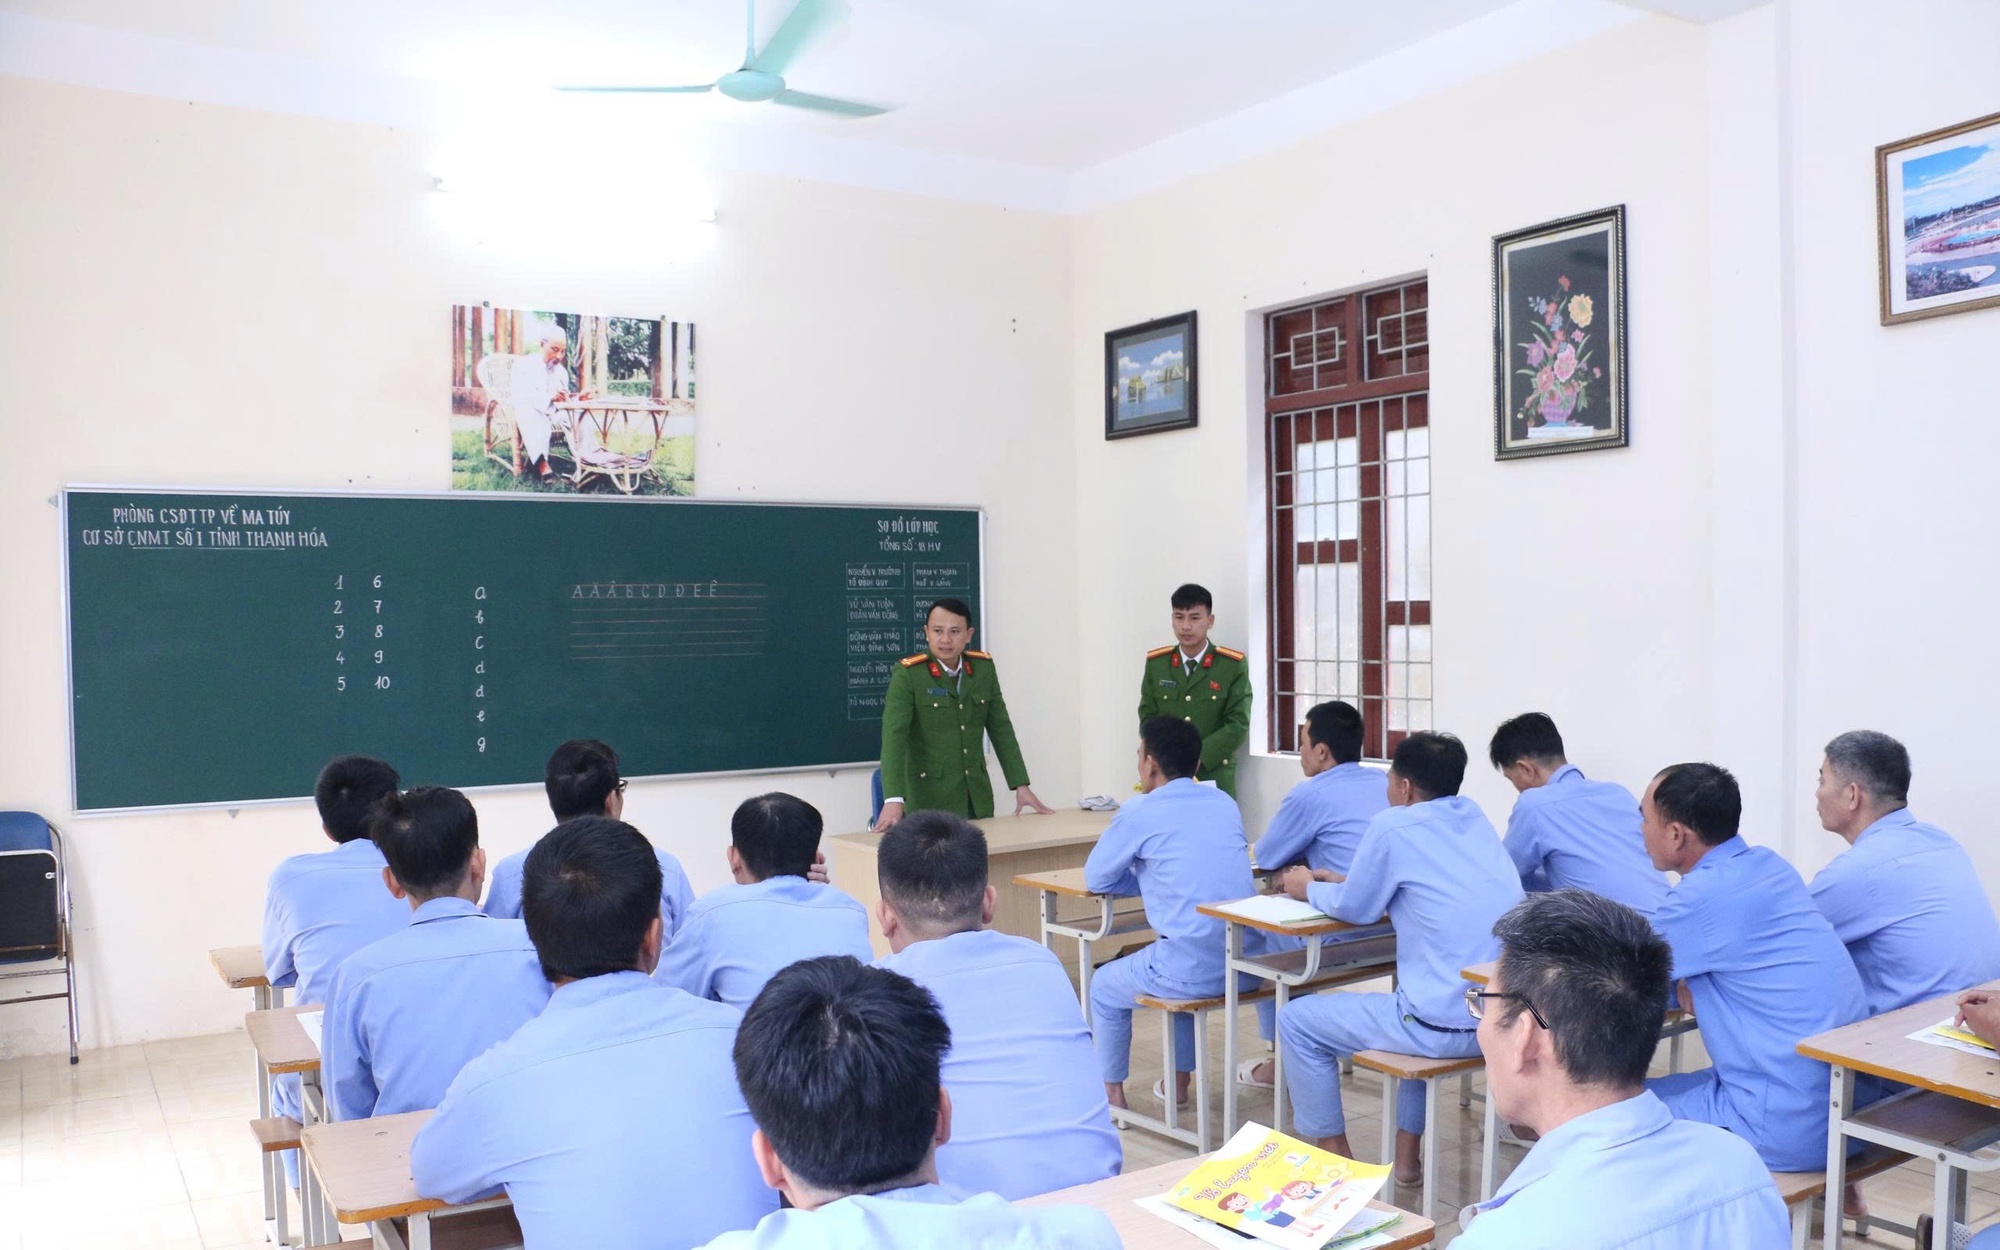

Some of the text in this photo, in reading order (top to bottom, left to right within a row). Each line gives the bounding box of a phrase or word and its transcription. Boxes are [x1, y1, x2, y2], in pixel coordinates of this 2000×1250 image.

[113, 503, 154, 523] PHÒNG
[221, 503, 239, 525] VỀ
[242, 509, 264, 525] MA
[266, 505, 290, 525] TÚY
[922, 520, 939, 536] HỌC
[82, 529, 100, 545] CƠ
[104, 526, 124, 545] SỞ
[127, 530, 170, 546] CNMT
[176, 527, 195, 546] SỐ
[208, 526, 240, 546] TỈNH
[245, 531, 295, 547] THANH
[298, 527, 328, 547] HÓA
[334, 574, 382, 590] 1 6
[572, 584, 583, 599] A
[626, 584, 633, 598] B
[641, 584, 650, 598] C
[658, 583, 666, 598] D
[675, 583, 685, 598] Đ
[693, 583, 701, 598] E
[333, 599, 382, 614] 2 7
[335, 624, 384, 639] 3 8
[336, 650, 384, 665] 4 9
[475, 660, 485, 674] d
[337, 675, 391, 691] 5 10
[476, 709, 486, 722] e
